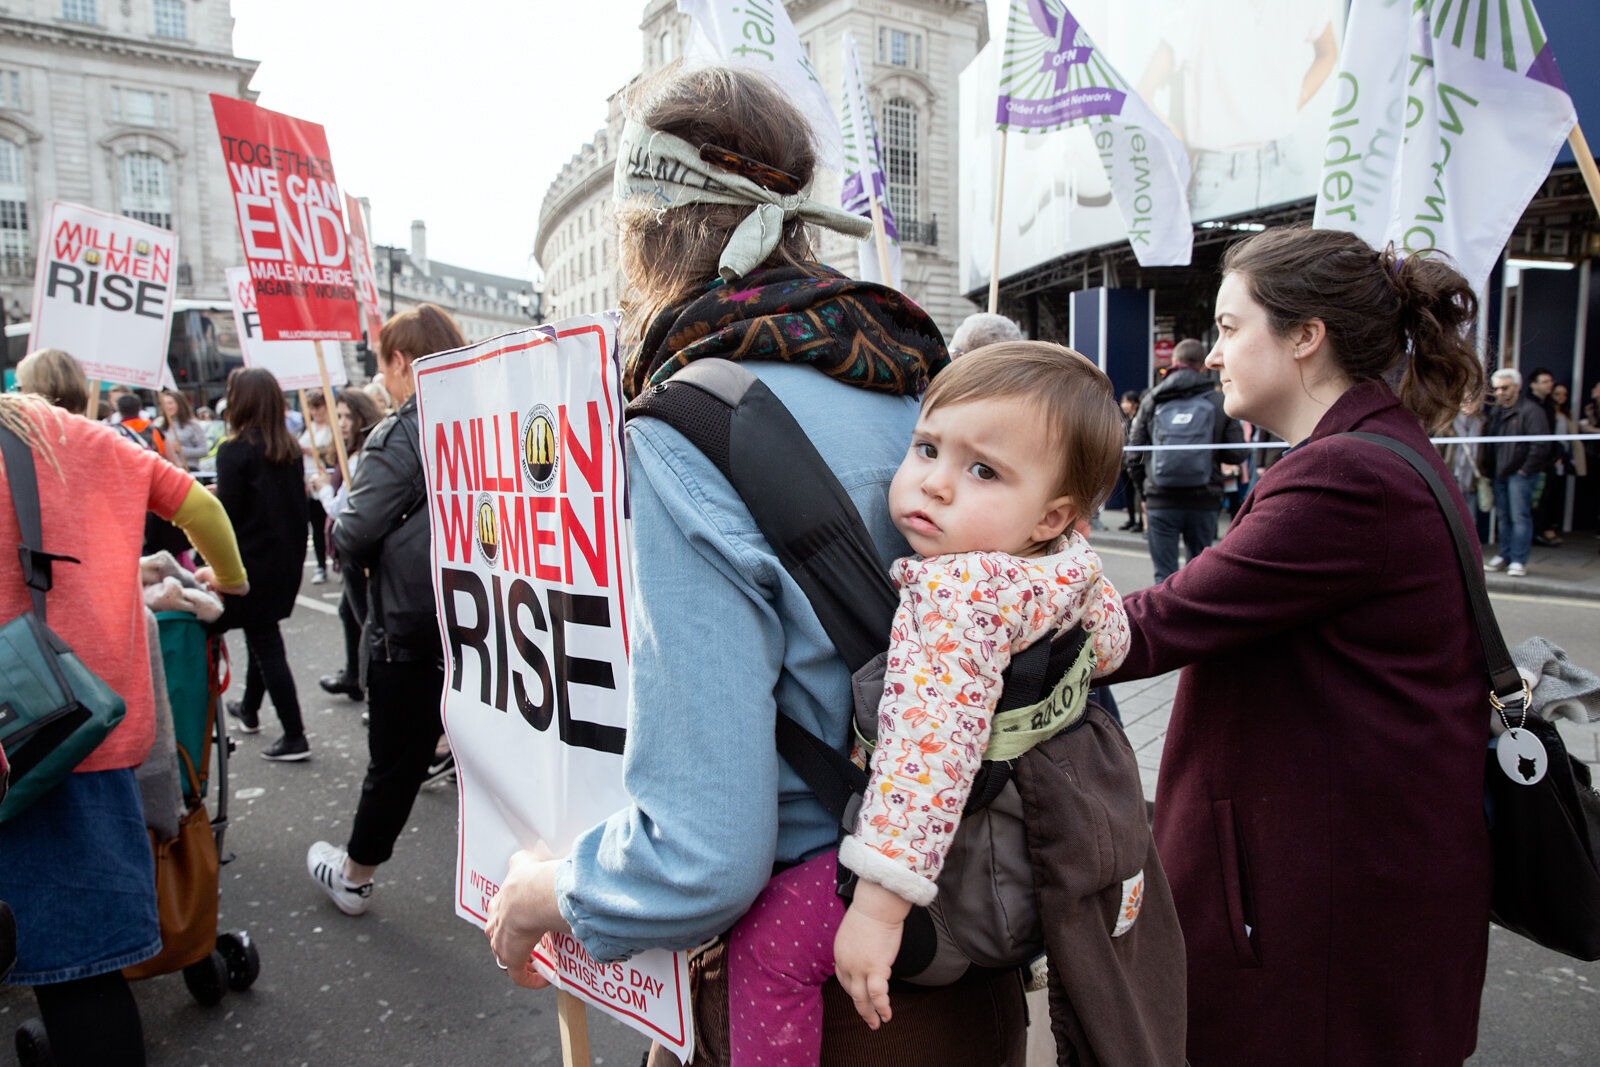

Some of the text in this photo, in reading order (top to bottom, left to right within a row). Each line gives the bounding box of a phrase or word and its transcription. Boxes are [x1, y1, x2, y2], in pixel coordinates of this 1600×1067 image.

[1052, 49, 1077, 67] OFN
[1005, 102, 1036, 115] Older
[1071, 92, 1112, 105] Network
[222, 136, 334, 182] TOGETHER
[1322, 71, 1362, 222] Older
[229, 162, 342, 211] WE CAN
[55, 220, 170, 265] MILLION
[236, 192, 350, 266] END
[55, 238, 170, 283] WOMEN
[250, 261, 354, 287] MALE VIOLENCE
[47, 261, 167, 320] RISE
[256, 280, 310, 298] AGAINST
[313, 284, 355, 300] WOMEN
[435, 401, 601, 493] MILLION
[436, 492, 608, 588] WOMEN
[441, 567, 626, 755] RISE
[630, 964, 664, 999] DAY
